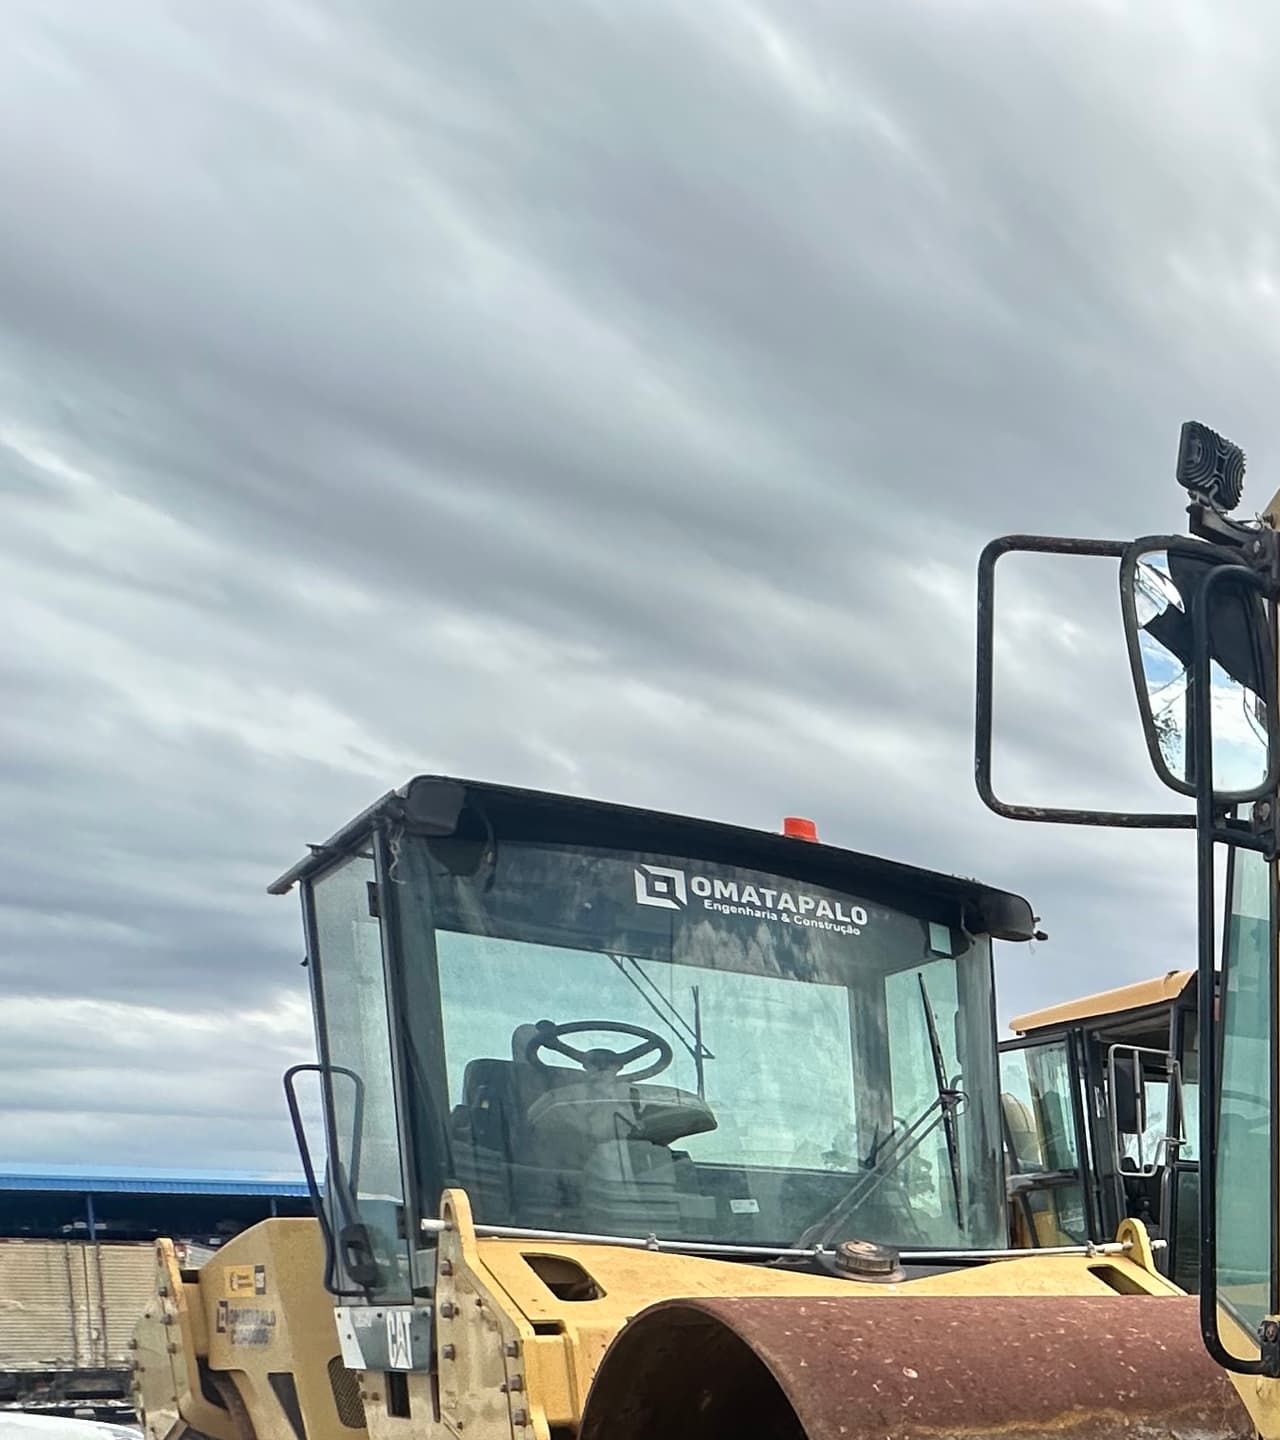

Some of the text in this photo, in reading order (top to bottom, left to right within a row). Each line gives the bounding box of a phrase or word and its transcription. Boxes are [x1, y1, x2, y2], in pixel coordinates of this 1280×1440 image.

[690, 876, 869, 926] OMATAPALO
[703, 899, 778, 921] Engenharia
[780, 912, 791, 924] &
[386, 1310, 413, 1369] CAT
